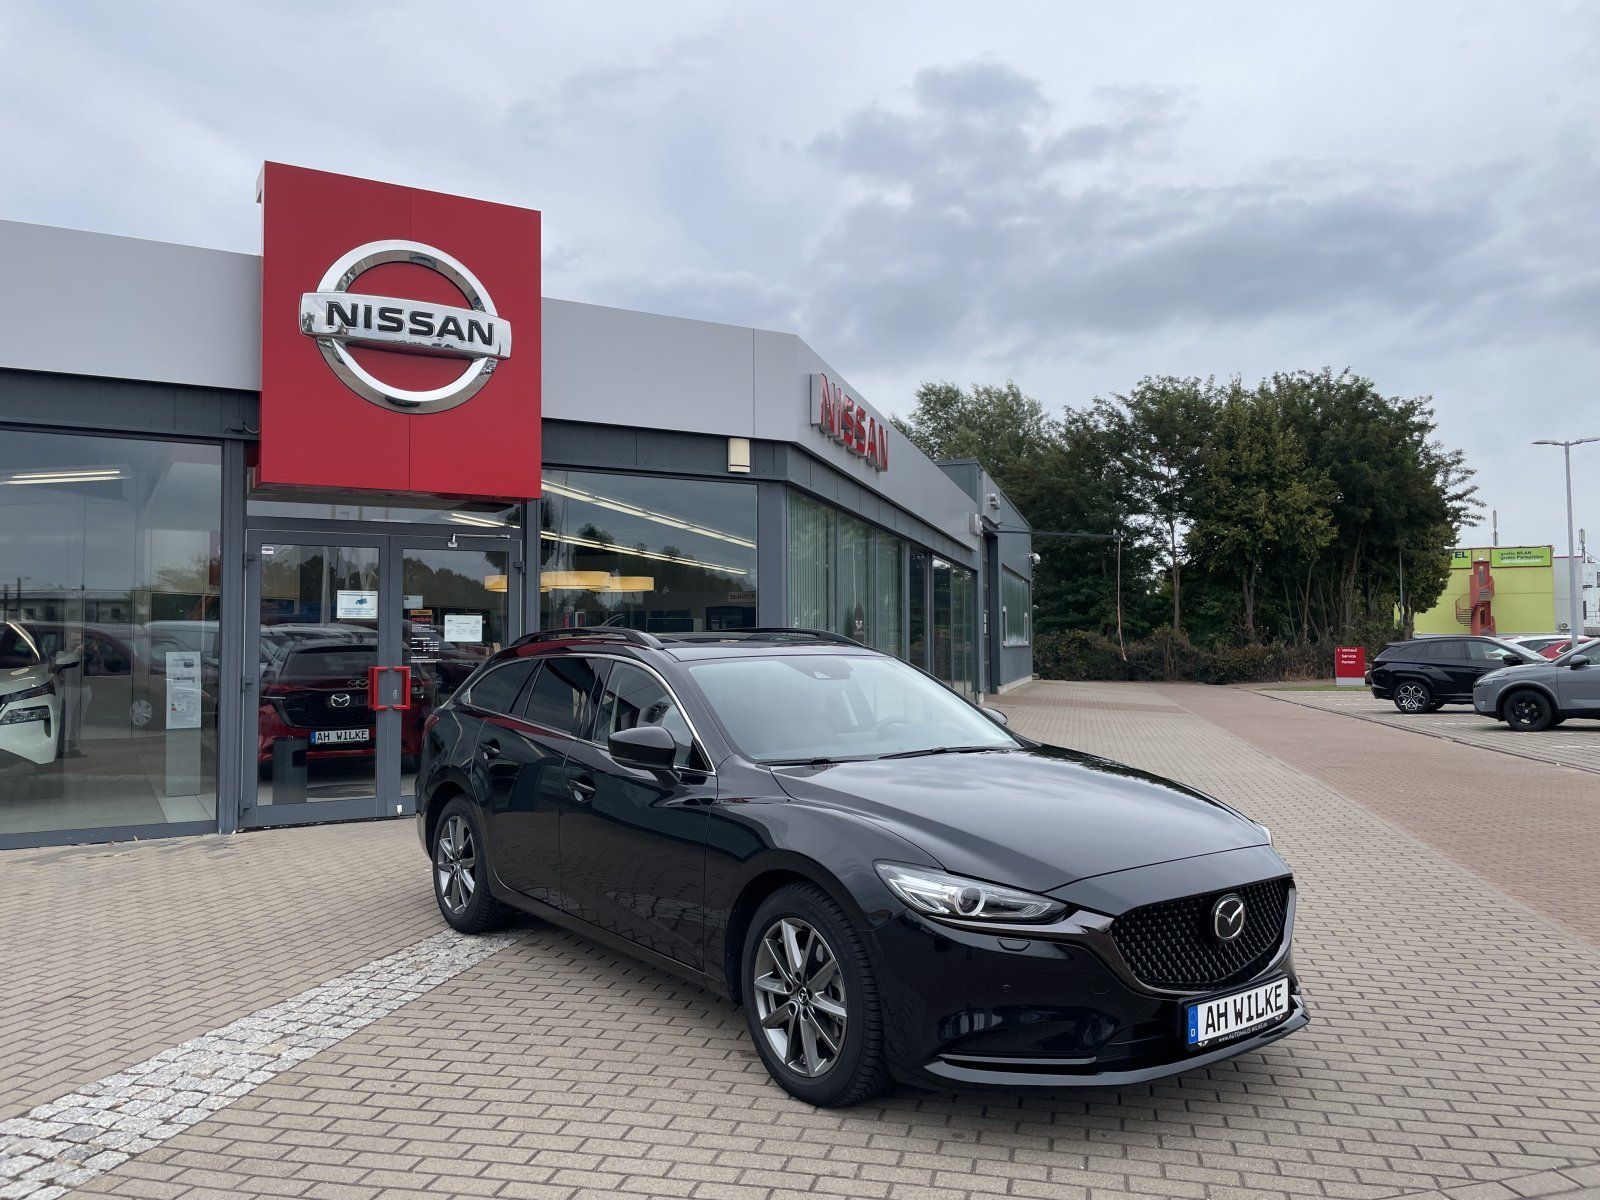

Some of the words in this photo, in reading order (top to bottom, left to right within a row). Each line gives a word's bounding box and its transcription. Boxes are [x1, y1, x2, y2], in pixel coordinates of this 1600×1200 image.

[325, 300, 495, 347] NISSAN
[812, 372, 888, 473] NISSAN
[317, 732, 330, 741] AH
[336, 730, 368, 740] WILKE
[1190, 1028, 1196, 1037] D
[1205, 1001, 1228, 1035] AH
[1233, 983, 1284, 1026] WILKE
